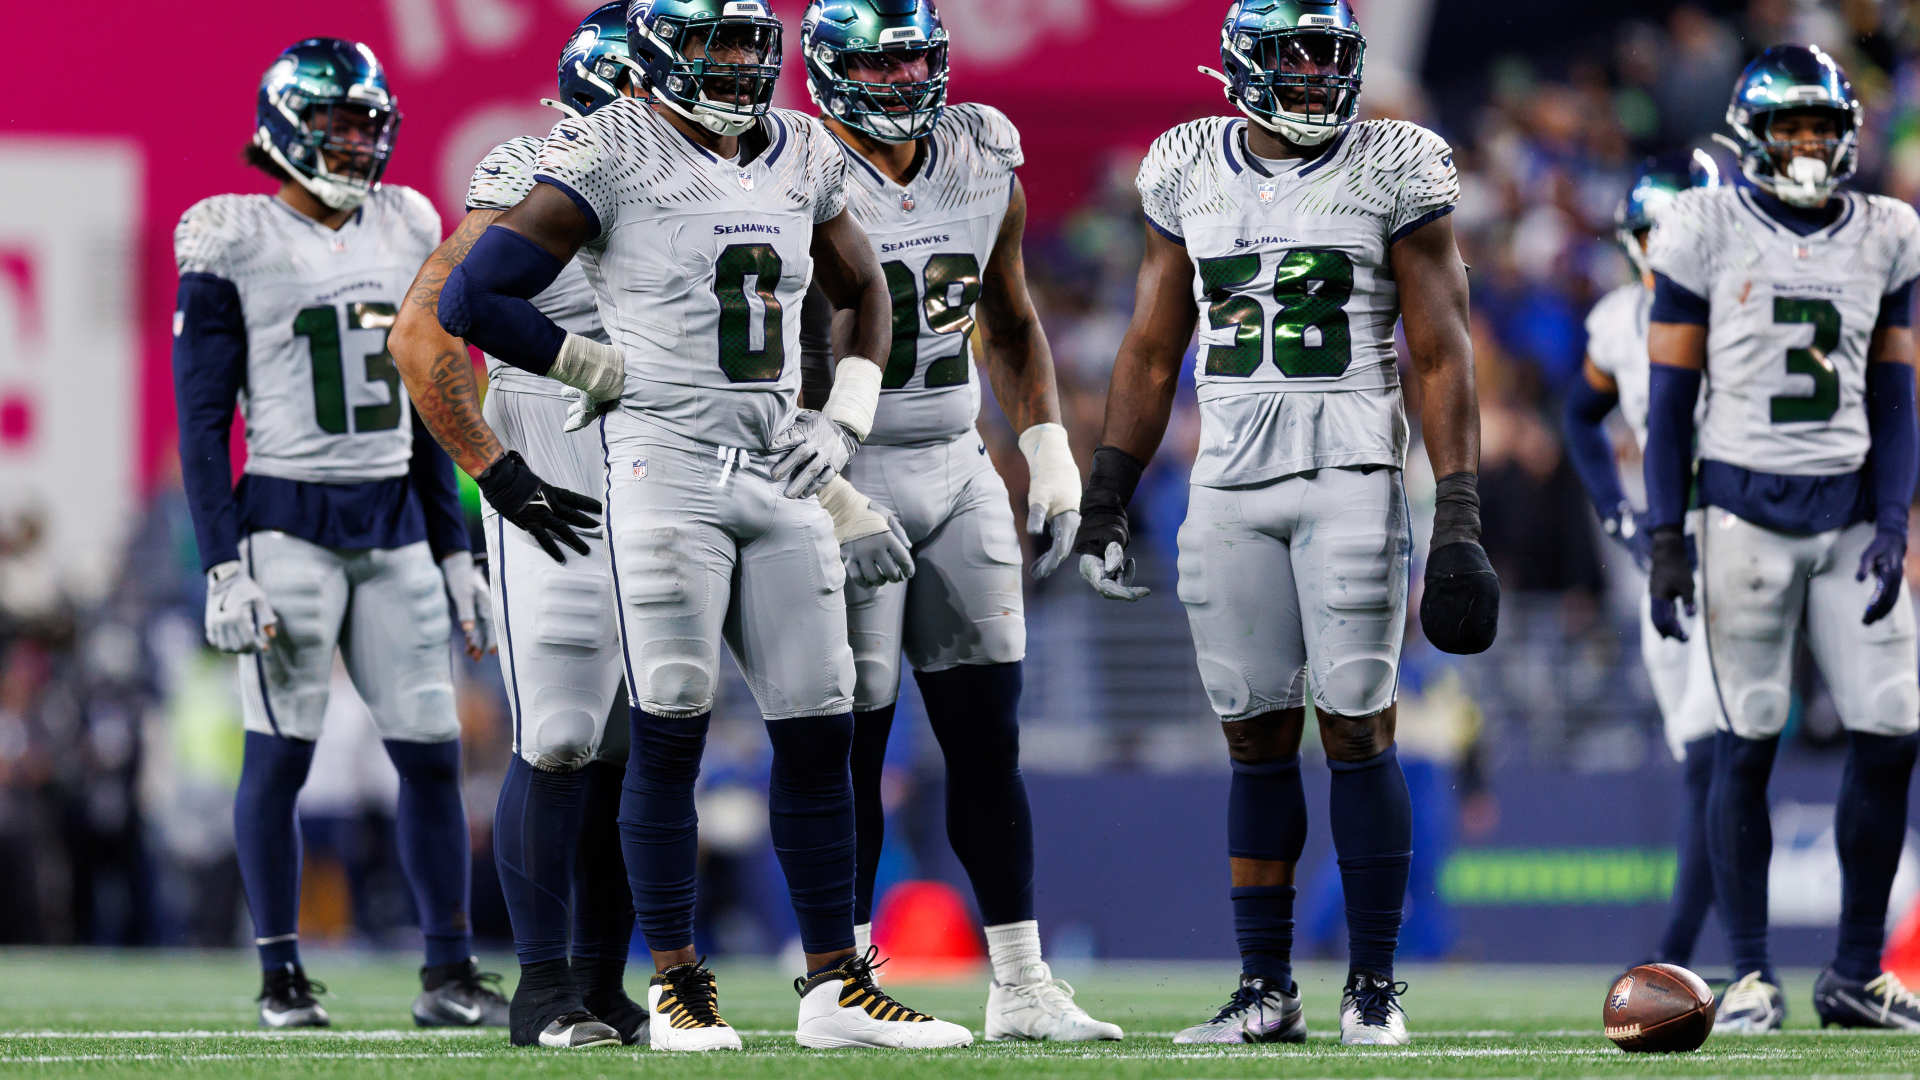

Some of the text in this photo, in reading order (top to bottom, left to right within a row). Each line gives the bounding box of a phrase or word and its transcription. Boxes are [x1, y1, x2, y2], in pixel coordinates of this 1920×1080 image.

[736, 3, 759, 11] SEAHAWKS
[1310, 16, 1334, 25] SEAHAWKS
[892, 29, 916, 38] SEAHAWKS
[713, 223, 781, 235] SEAHAWKS
[881, 234, 950, 253] SEAHAWKS
[1233, 236, 1301, 248] SEAHAW
[714, 243, 785, 383] 0
[1197, 248, 1355, 378] 58
[1769, 296, 1842, 424] 3
[292, 302, 402, 435] 13
